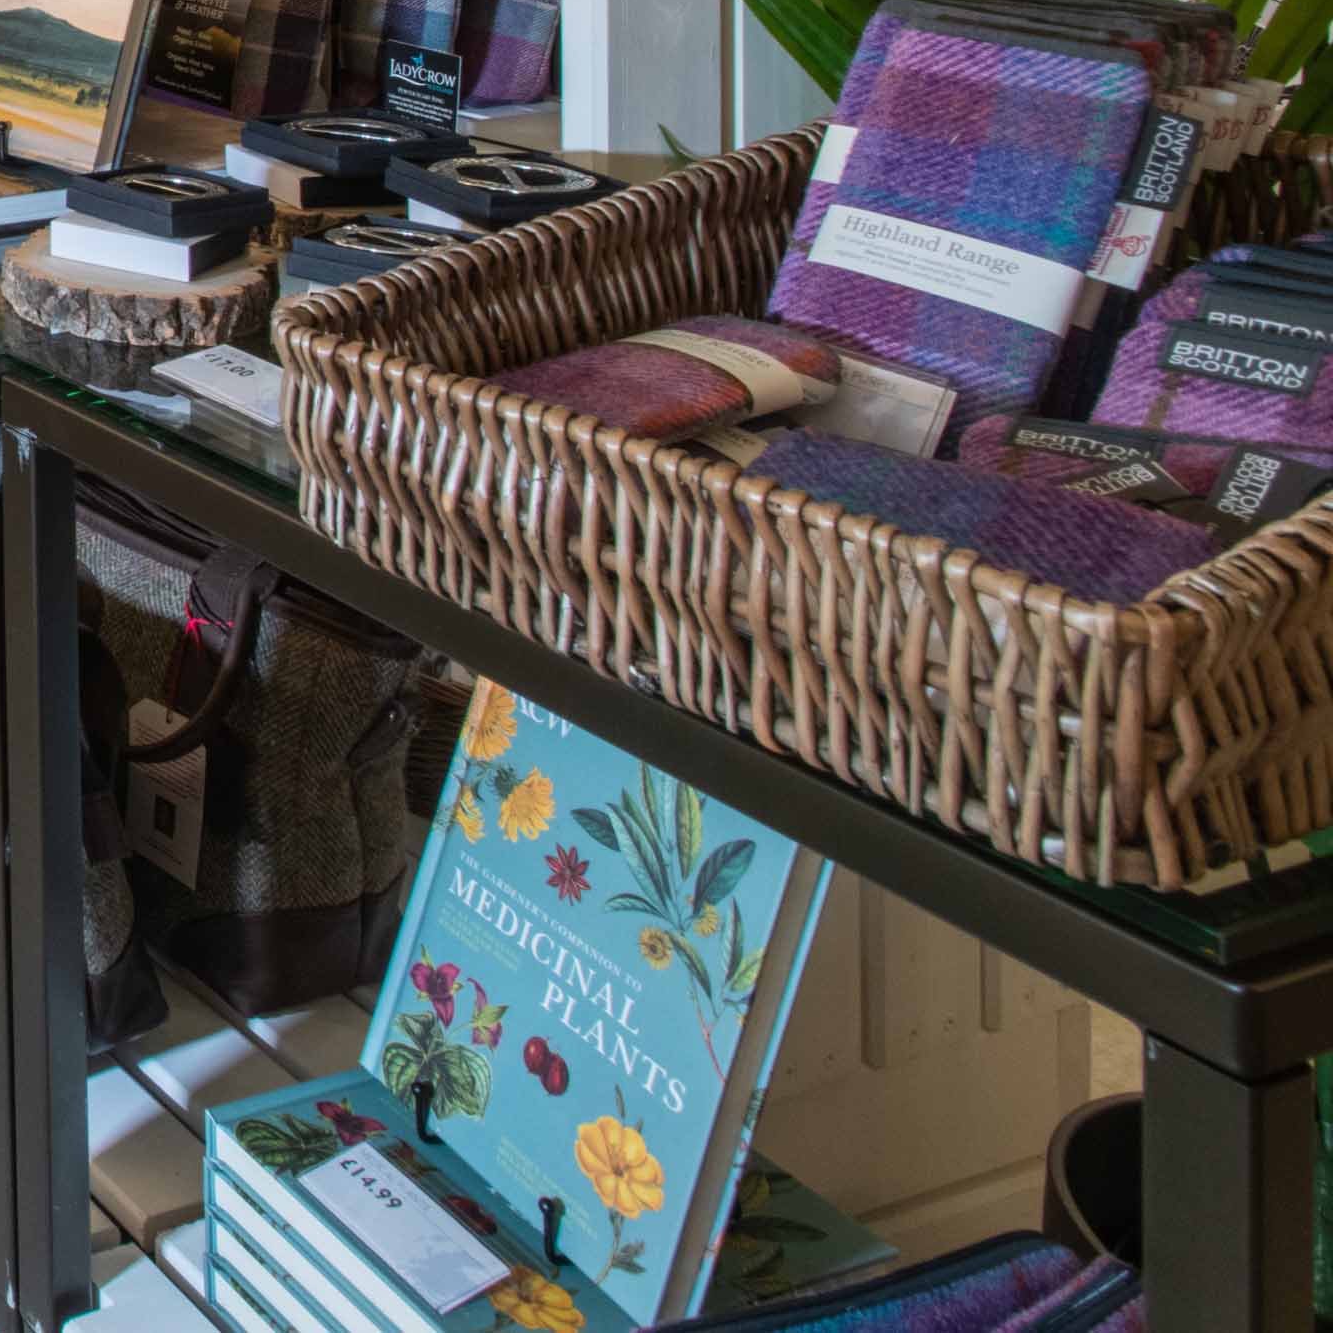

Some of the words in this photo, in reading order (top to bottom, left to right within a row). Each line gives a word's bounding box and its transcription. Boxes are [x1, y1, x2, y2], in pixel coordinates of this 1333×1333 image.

[185, 2, 224, 20] HEATHER
[389, 58, 457, 88] LADYCROW
[1134, 115, 1181, 203] BRITTON
[1154, 121, 1195, 204] SCOTLAND
[842, 214, 942, 254] Highland
[946, 240, 1021, 276] Range
[1168, 353, 1303, 389] SCOTLAND
[1172, 340, 1308, 380] BRITTON
[1217, 451, 1256, 514] SCOTLAND
[1232, 454, 1282, 523] BRITTON
[447, 866, 640, 1036] MEDICINAL
[460, 849, 480, 873] THE
[482, 868, 550, 924] GARDENER'S
[549, 917, 622, 977] COMPANION
[625, 971, 644, 993] TO
[540, 978, 687, 1114] PLANTS
[339, 1159, 403, 1209] £14.99
